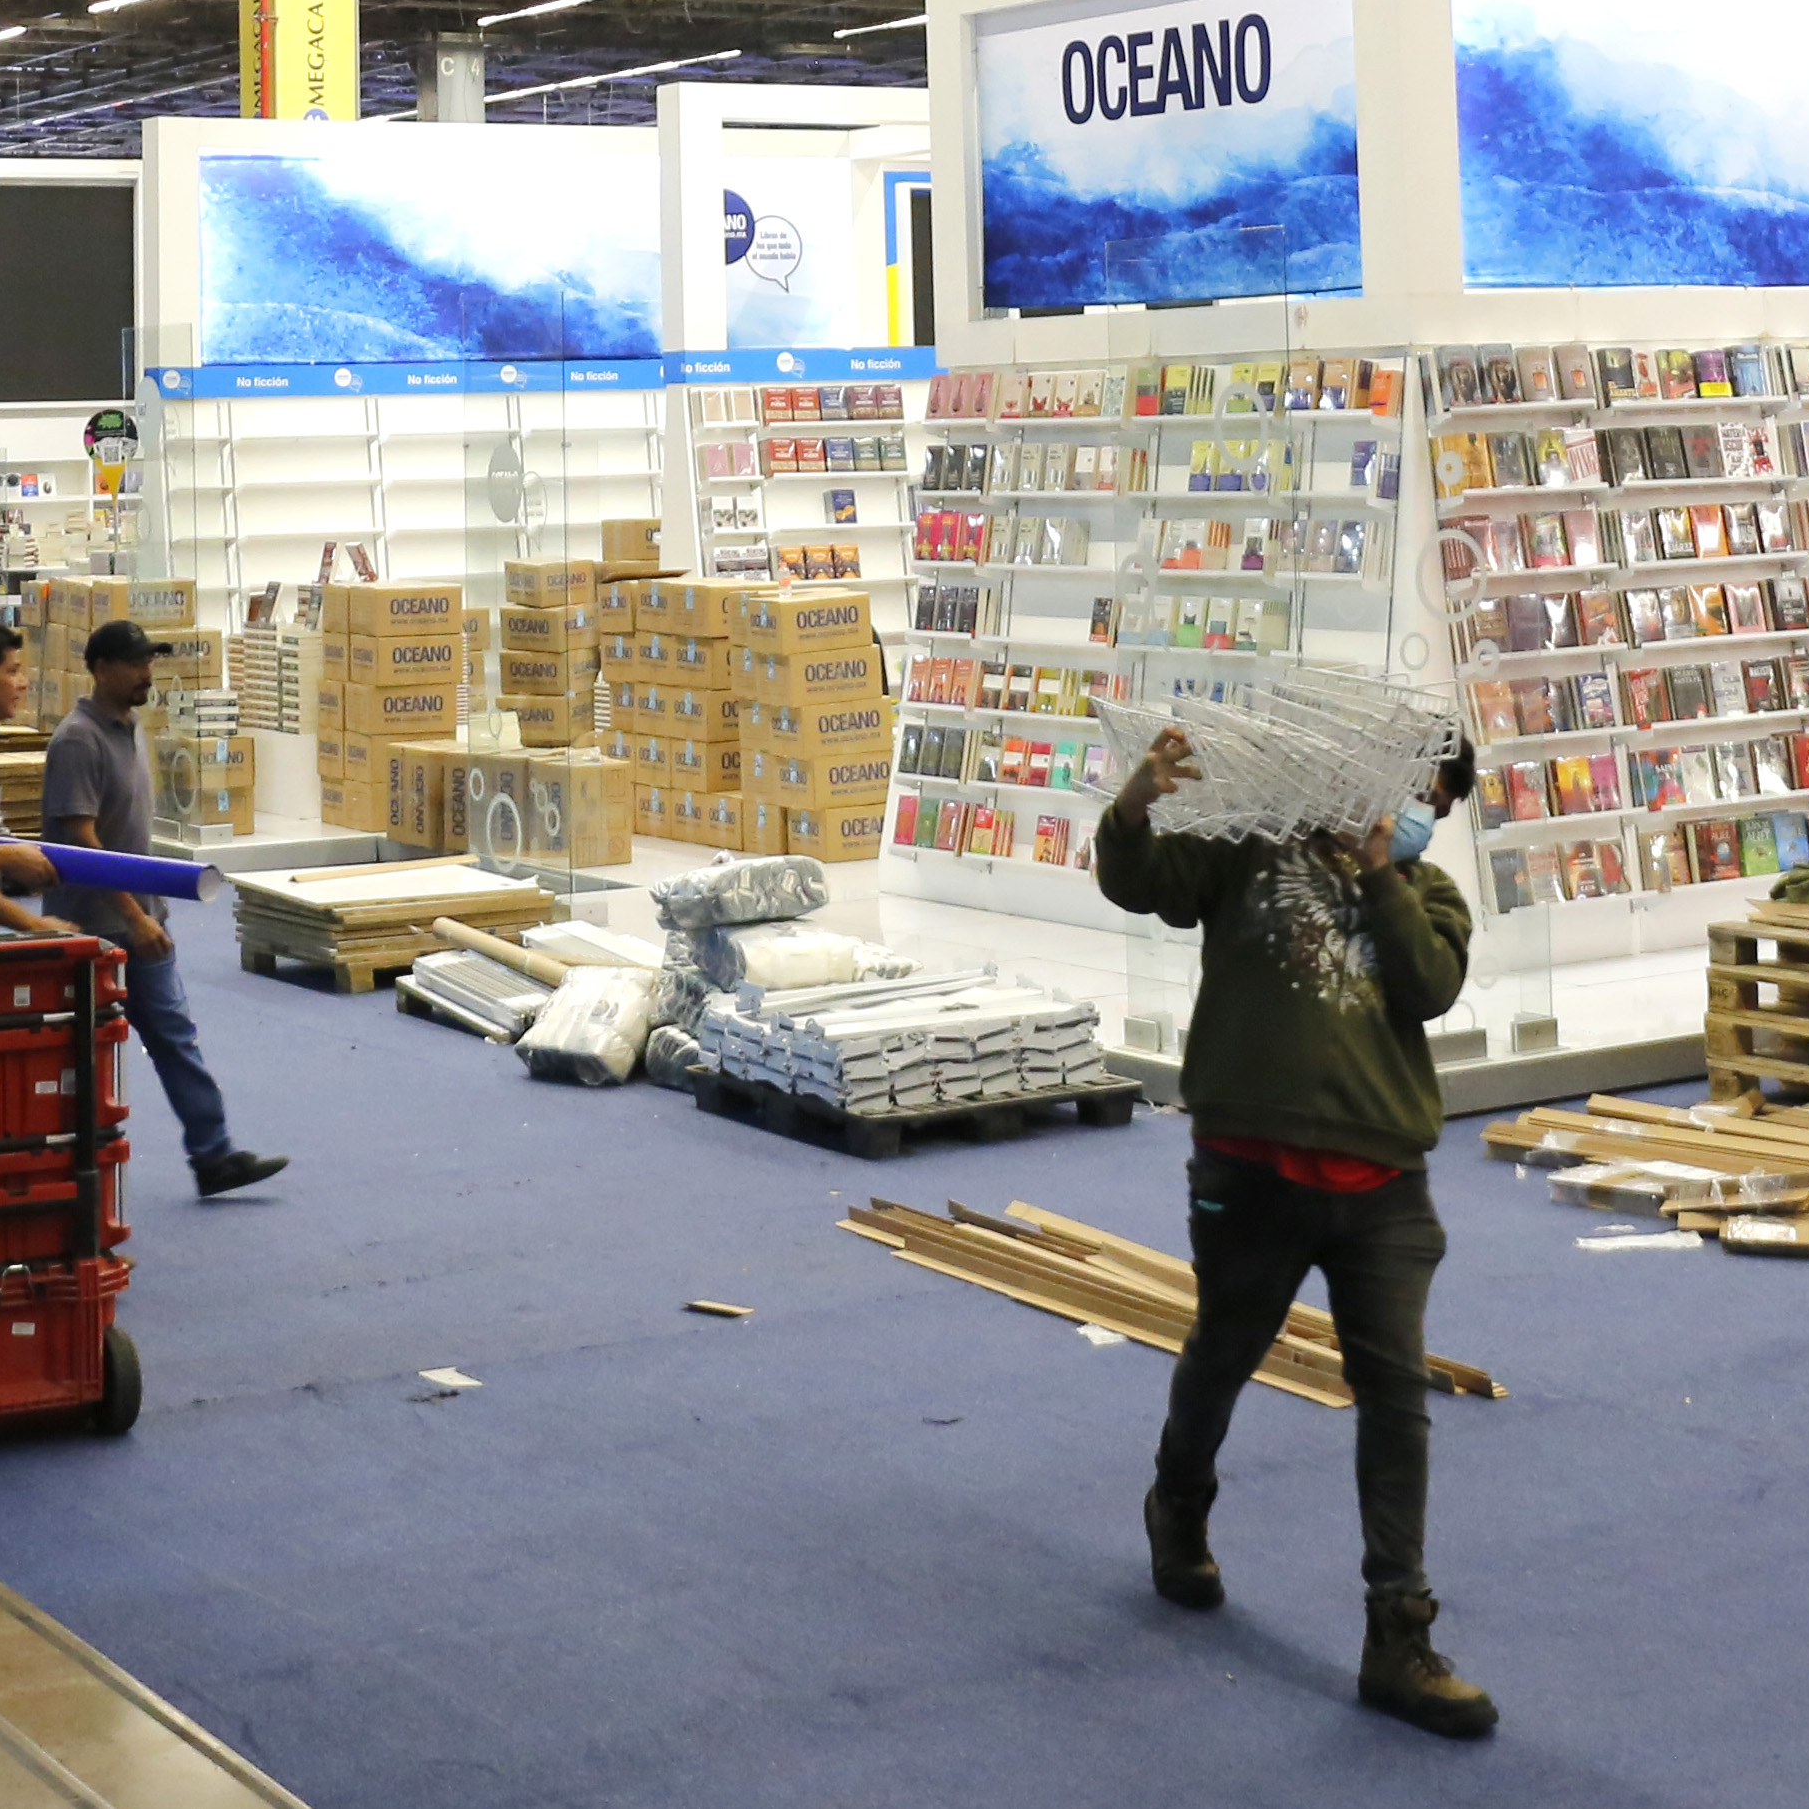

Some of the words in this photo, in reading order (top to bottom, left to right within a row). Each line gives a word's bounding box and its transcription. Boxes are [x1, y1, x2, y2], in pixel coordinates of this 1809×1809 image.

[1061, 13, 1272, 126] OCEANO
[693, 360, 731, 373] ficción
[851, 358, 866, 370] No
[865, 357, 902, 370] ficción
[236, 376, 252, 388] No
[253, 374, 289, 388] ficción
[407, 374, 421, 386] No
[422, 373, 457, 386] ficción
[570, 370, 583, 382] No
[585, 369, 619, 382] ficción
[391, 597, 449, 615] OCEANO
[797, 605, 859, 628] OCEANO
[509, 618, 549, 634] OCEANO
[393, 645, 451, 664] OCEANO
[511, 663, 557, 678] OCEANO
[805, 659, 867, 682] OCEANO
[384, 696, 443, 713] OCEANO
[819, 709, 881, 733] OCEANO
[829, 760, 890, 784] OCEANO
[453, 768, 465, 836] OCEANO
